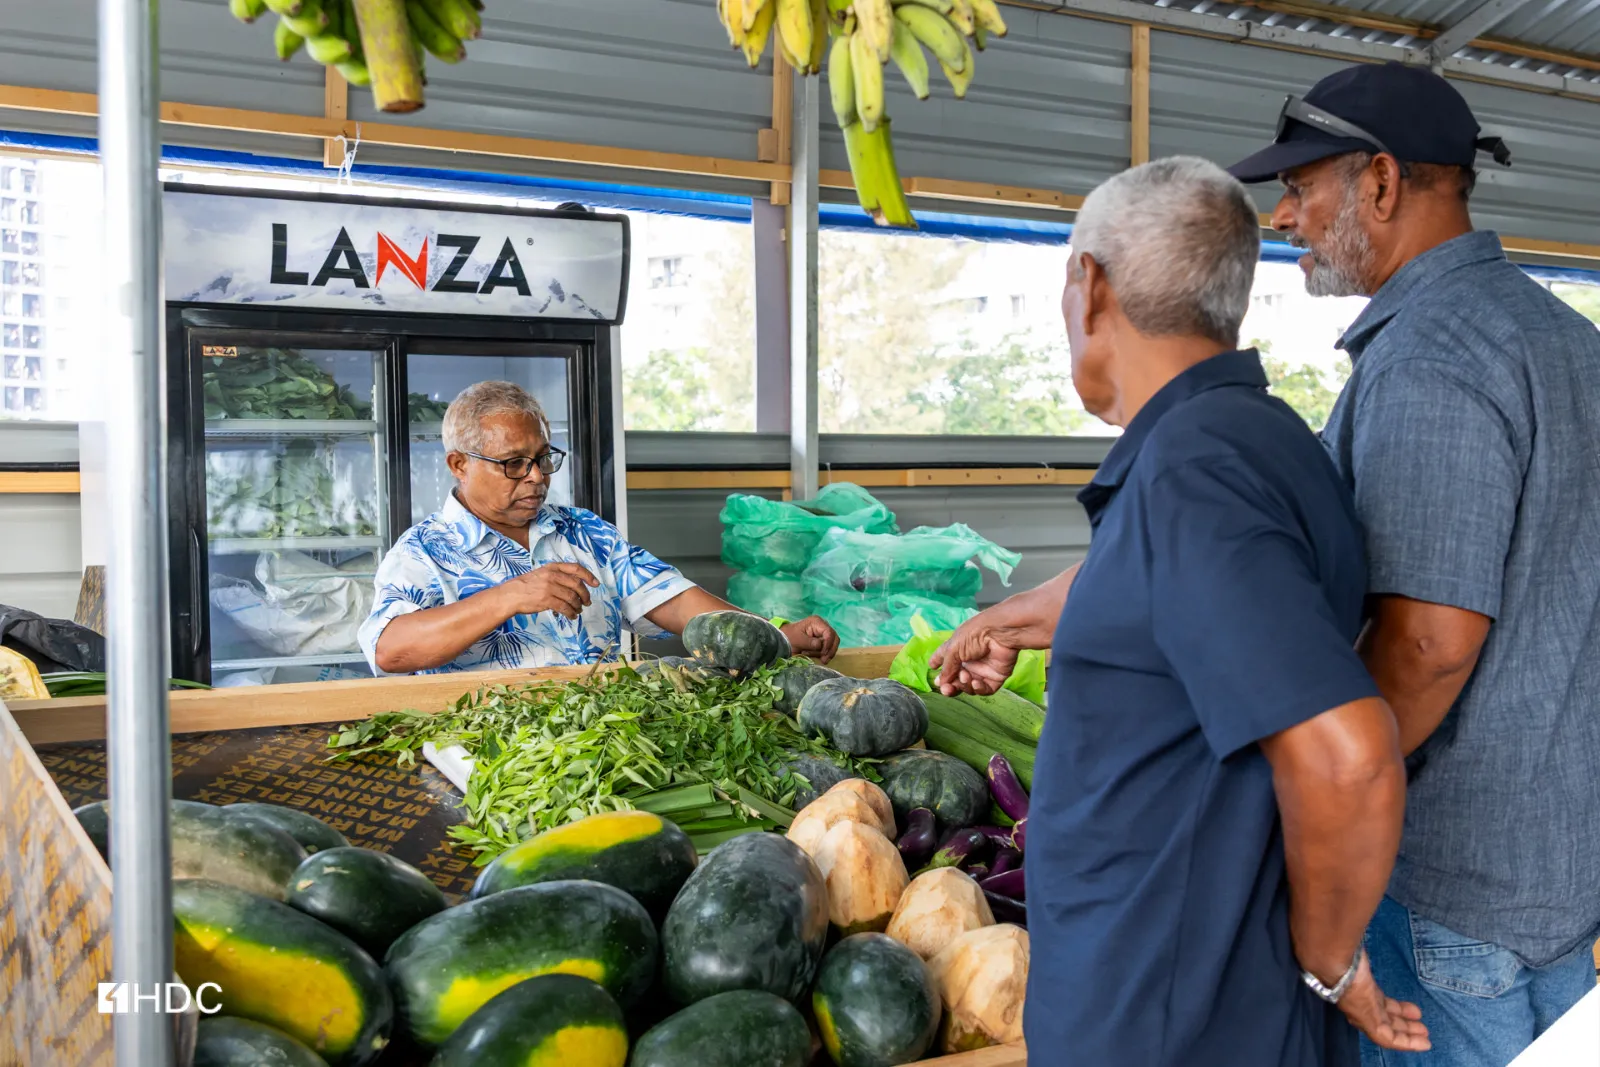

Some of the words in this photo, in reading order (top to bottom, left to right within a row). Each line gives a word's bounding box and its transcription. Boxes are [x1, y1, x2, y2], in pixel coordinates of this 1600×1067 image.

[270, 223, 531, 296] LANZA
[204, 347, 235, 355] LANZA
[224, 765, 431, 817] MARINEPLEX
[239, 755, 443, 805] MARINEPLEX
[255, 744, 455, 793] MARINEPLEX
[208, 777, 419, 829] MARINEPLEX
